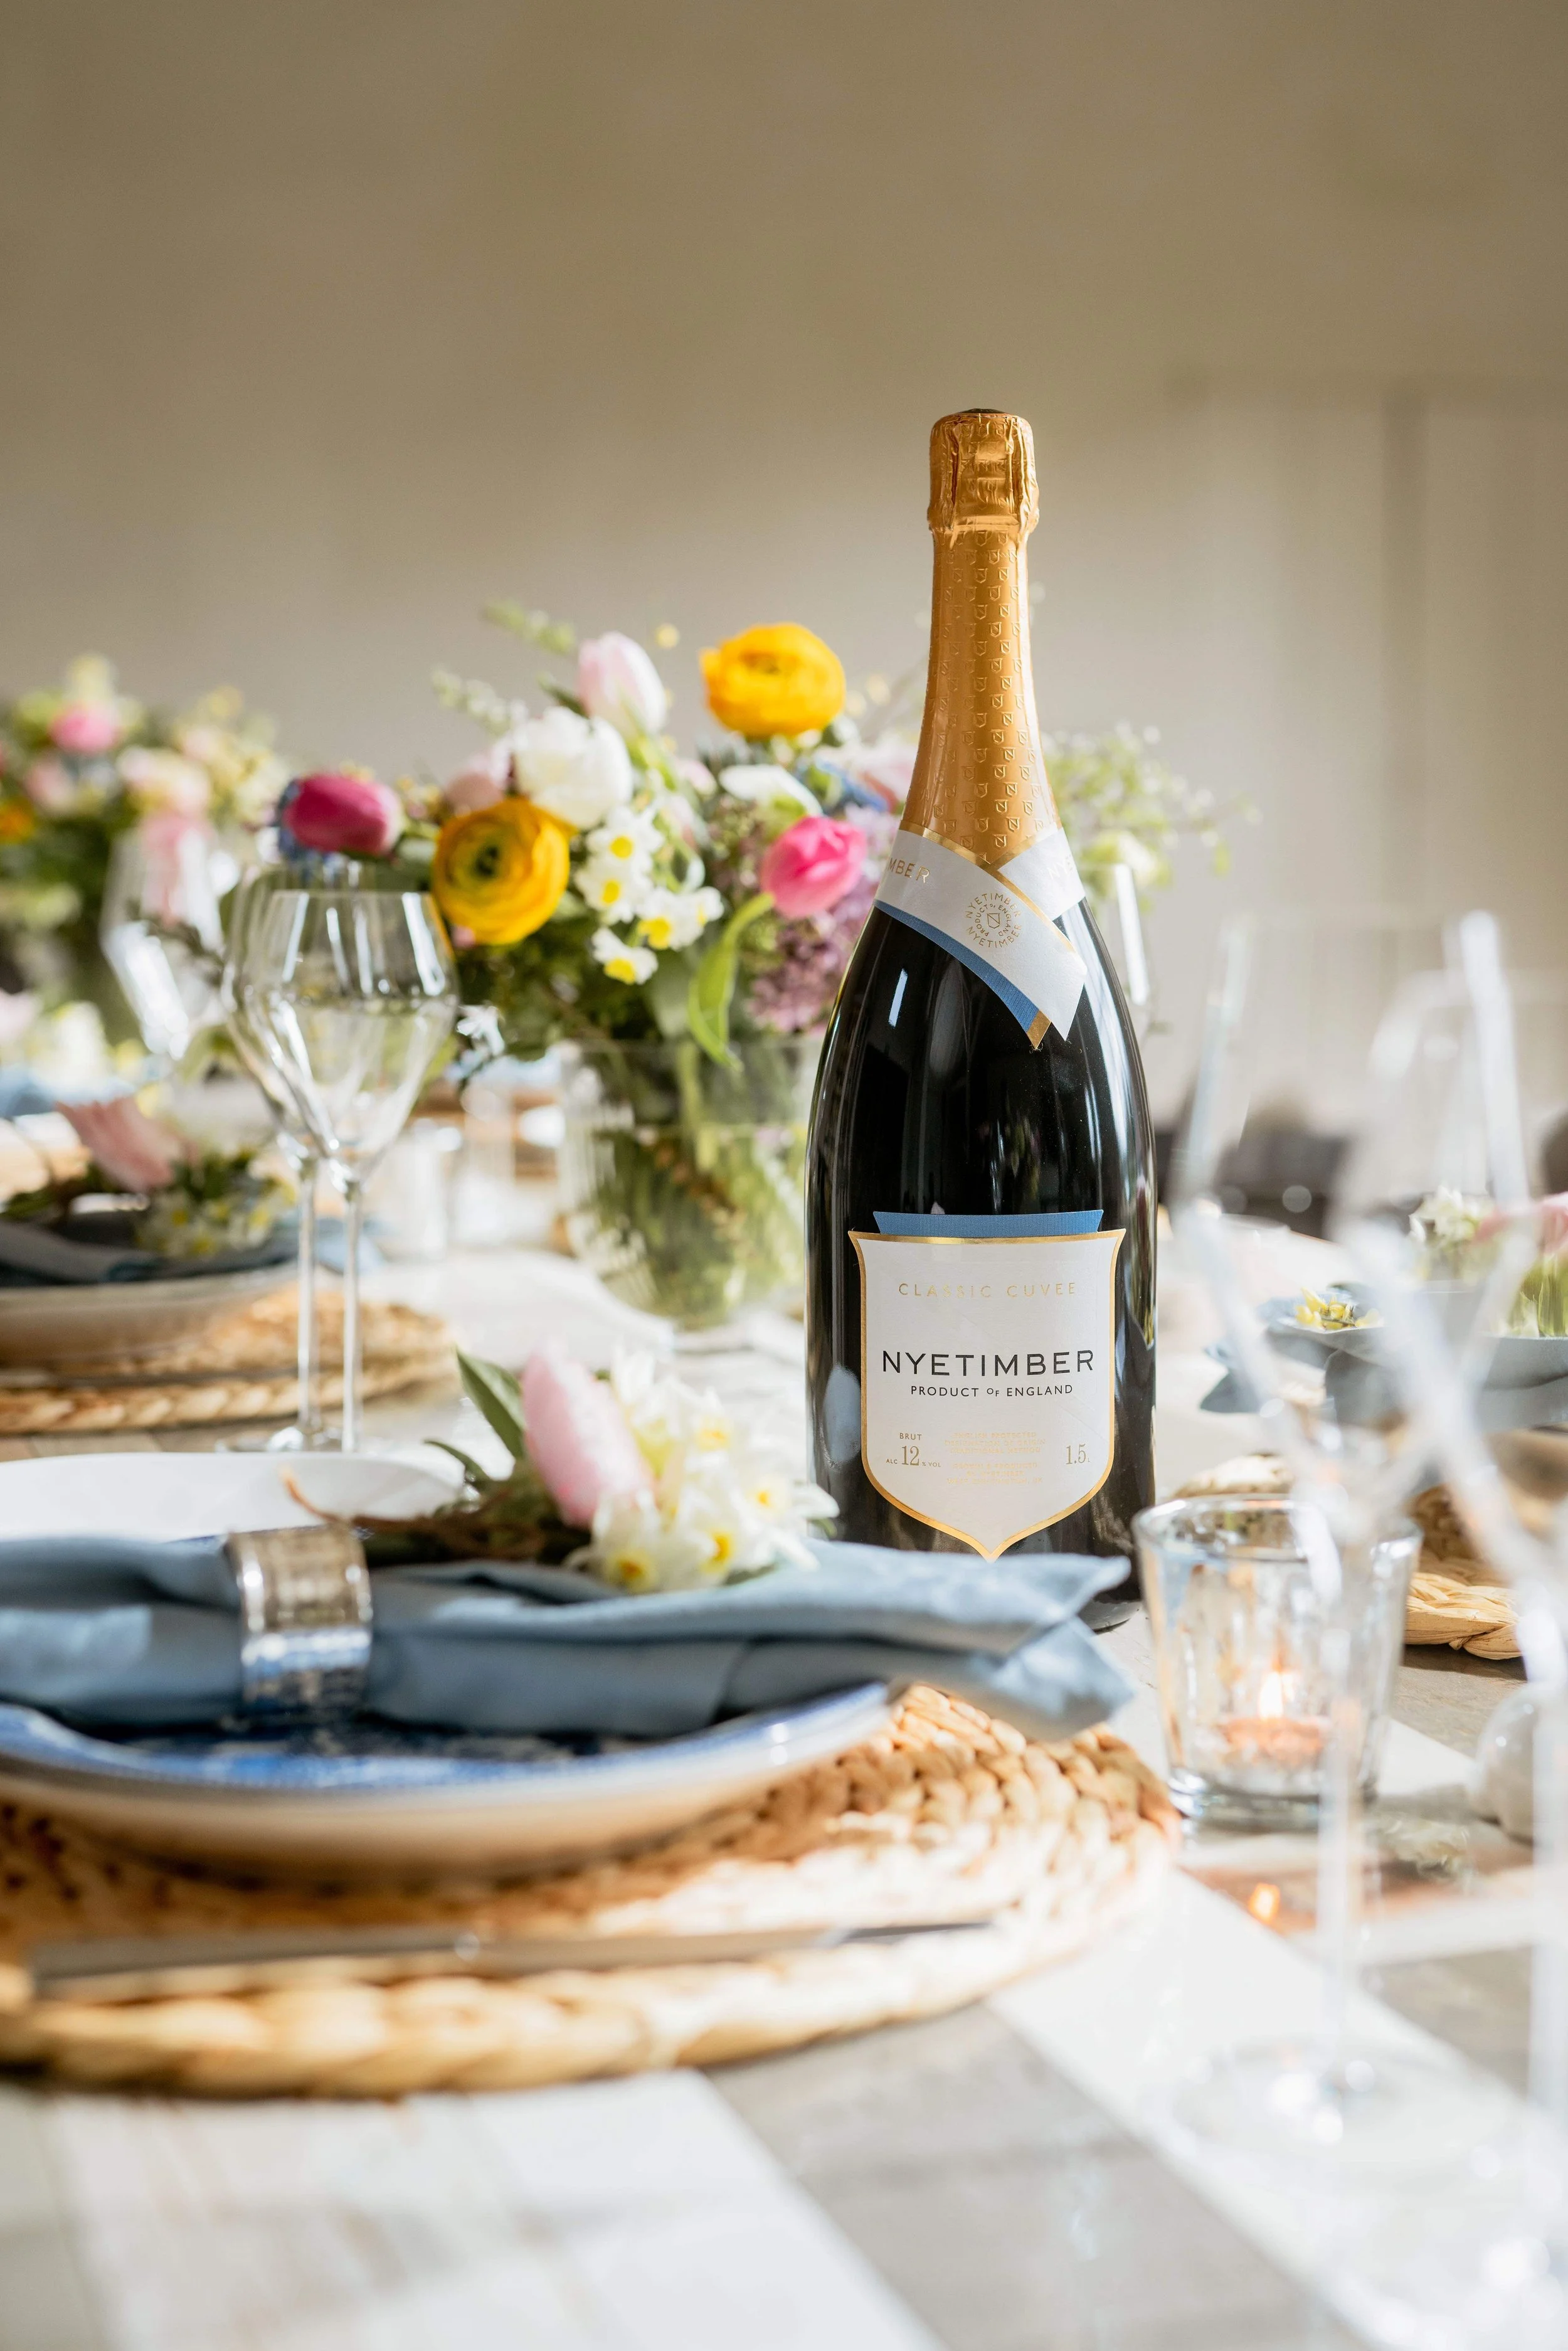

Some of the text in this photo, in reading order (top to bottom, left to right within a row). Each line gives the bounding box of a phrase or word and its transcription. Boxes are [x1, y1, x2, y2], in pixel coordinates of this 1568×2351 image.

[965, 893, 1020, 919] NYETIMBER
[975, 904, 989, 937] PRODUCT
[998, 905, 1012, 937] ENGLAND
[967, 924, 1022, 948] NYETIMBER
[898, 1282, 1075, 1298] CLASSIC CUVEE
[882, 1350, 1093, 1376] NYETIMBER
[911, 1384, 1073, 1397] PRODUCT OF ENGLAND
[1066, 1443, 1086, 1465] 1.5
